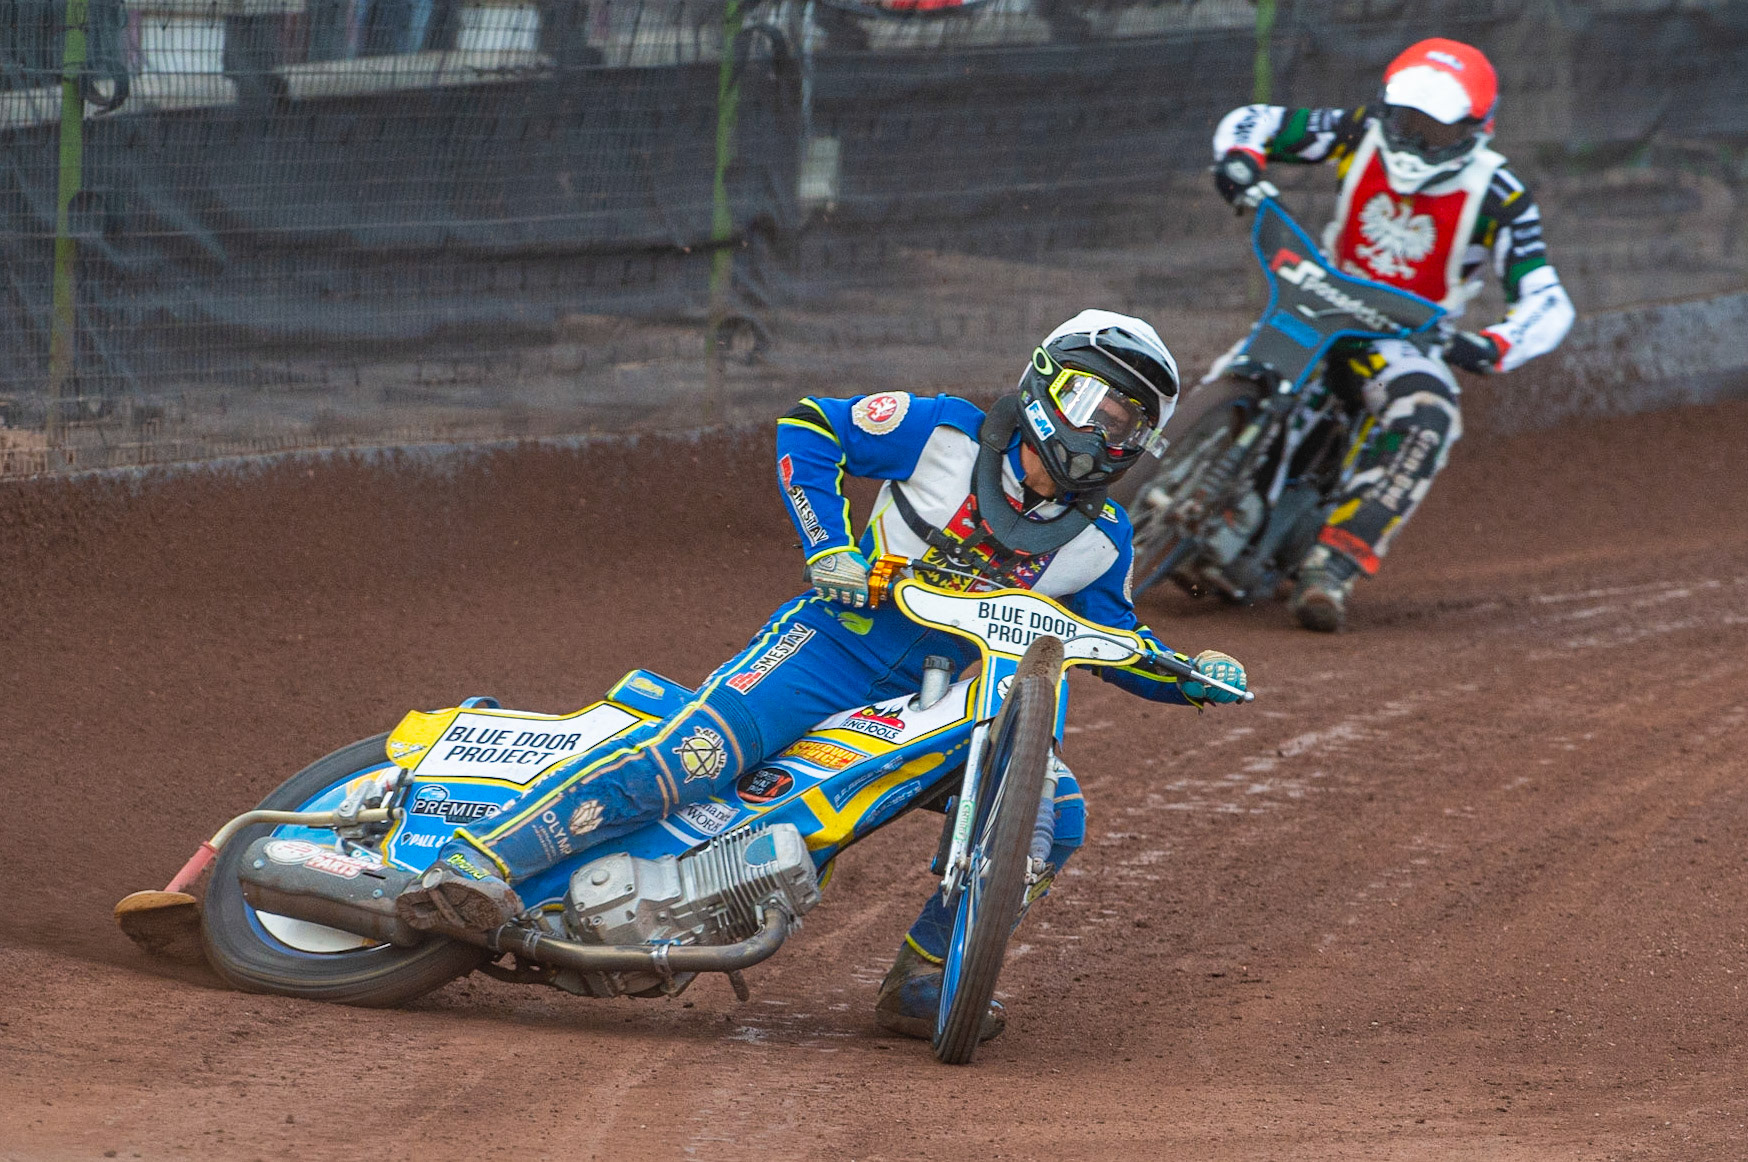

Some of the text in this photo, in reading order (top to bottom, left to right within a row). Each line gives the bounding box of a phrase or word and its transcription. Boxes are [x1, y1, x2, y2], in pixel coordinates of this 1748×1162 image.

[978, 601, 1077, 638] BLUE DOOR
[987, 623, 1042, 646] PROJ
[753, 623, 809, 672] SMESTAV
[444, 726, 582, 751] BLUE DOOR
[443, 745, 555, 765] PROJECT
